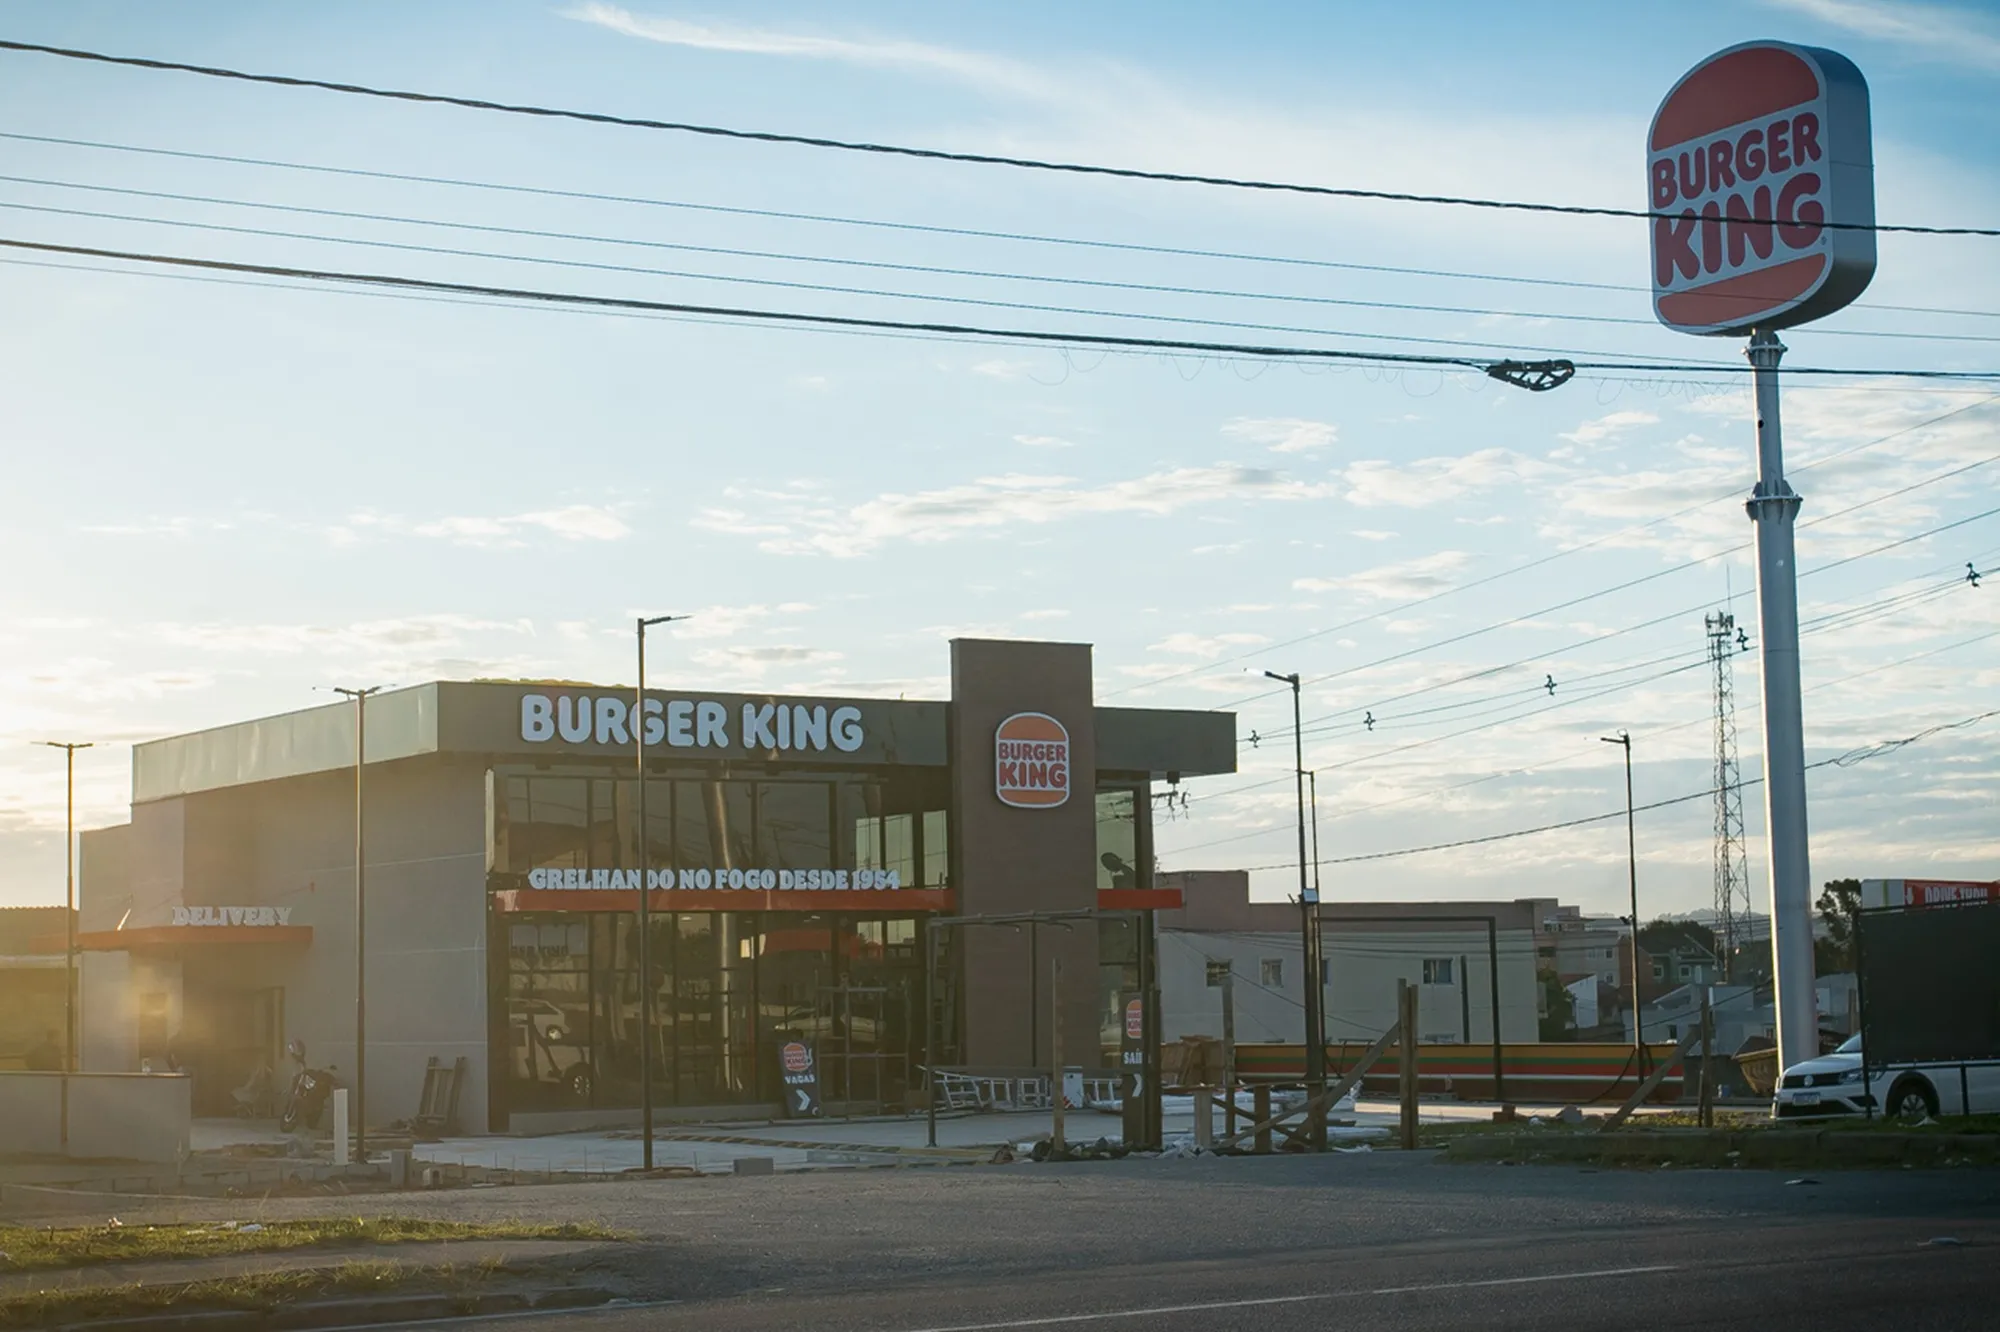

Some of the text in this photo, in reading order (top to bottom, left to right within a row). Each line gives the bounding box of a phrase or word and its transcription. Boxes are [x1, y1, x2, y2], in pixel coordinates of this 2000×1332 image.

[1652, 112, 1822, 209] BURGER
[1655, 172, 1825, 287] KING
[521, 694, 864, 752] BURGER KING
[999, 742, 1066, 761] BURGER
[999, 761, 1067, 788] KING
[528, 868, 900, 890] GRELHANDO NO FOGO DESDE 1954
[172, 906, 292, 926] DELIVERY
[784, 1075, 815, 1084] VAGAS
